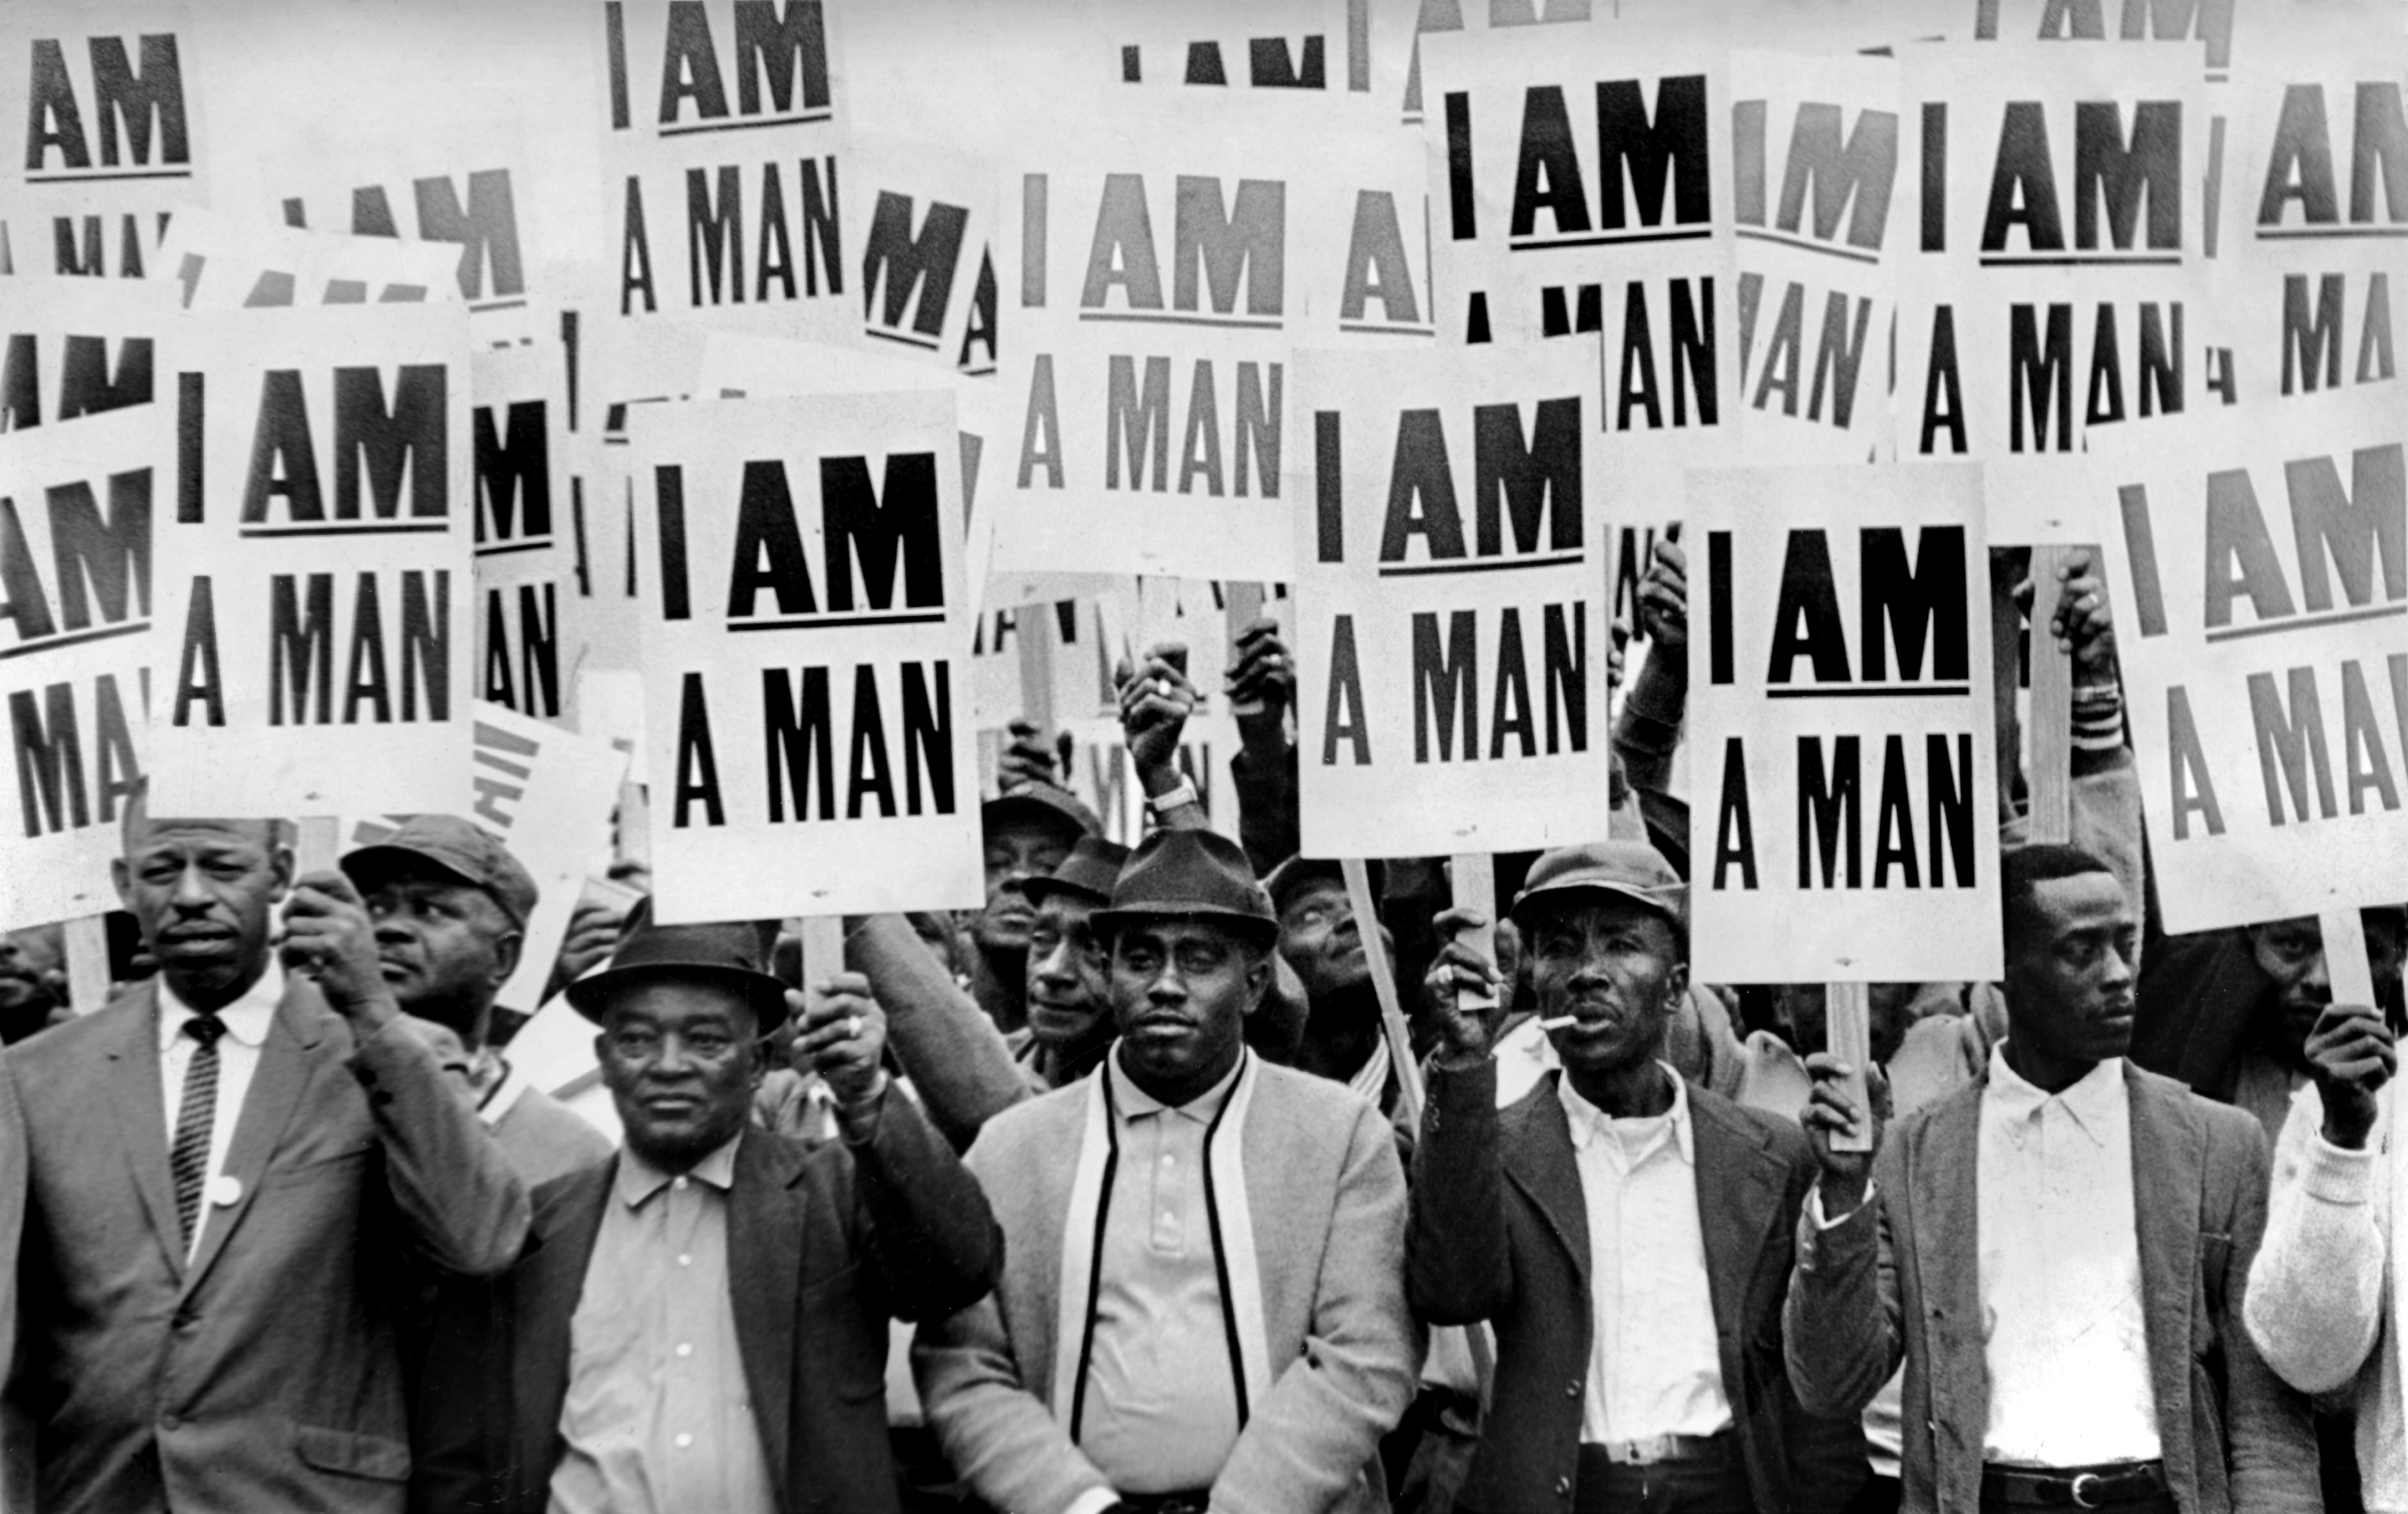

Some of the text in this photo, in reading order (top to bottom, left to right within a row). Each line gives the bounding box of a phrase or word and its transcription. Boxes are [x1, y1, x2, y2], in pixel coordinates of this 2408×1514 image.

[25, 33, 191, 170] AM
[659, 0, 831, 124] AM
[621, 155, 843, 316] A MAN
[1445, 74, 1711, 240] I AM
[1920, 102, 1948, 253] I
[1980, 100, 2183, 252] AM
[1021, 173, 1286, 316] I AM
[1340, 189, 1435, 324] A
[177, 372, 205, 524] I
[239, 363, 449, 523] AM
[1017, 354, 1063, 490] A
[1106, 354, 1284, 498] MAN
[1919, 304, 1969, 454] A
[2009, 301, 2185, 454] MAN
[656, 464, 691, 620] I
[727, 452, 945, 618] AM
[1315, 395, 1584, 563] I AM
[2118, 443, 2408, 638] I AM
[173, 569, 450, 727] A MAN
[1322, 614, 1372, 766] A
[1411, 600, 1589, 765] MAN
[1708, 531, 1734, 684] I
[1767, 525, 1970, 683] AM
[9, 667, 151, 838] MA
[673, 672, 726, 828] A
[761, 660, 957, 824] MAN
[1712, 733, 1977, 890] A MAN
[2167, 685, 2227, 841] A
